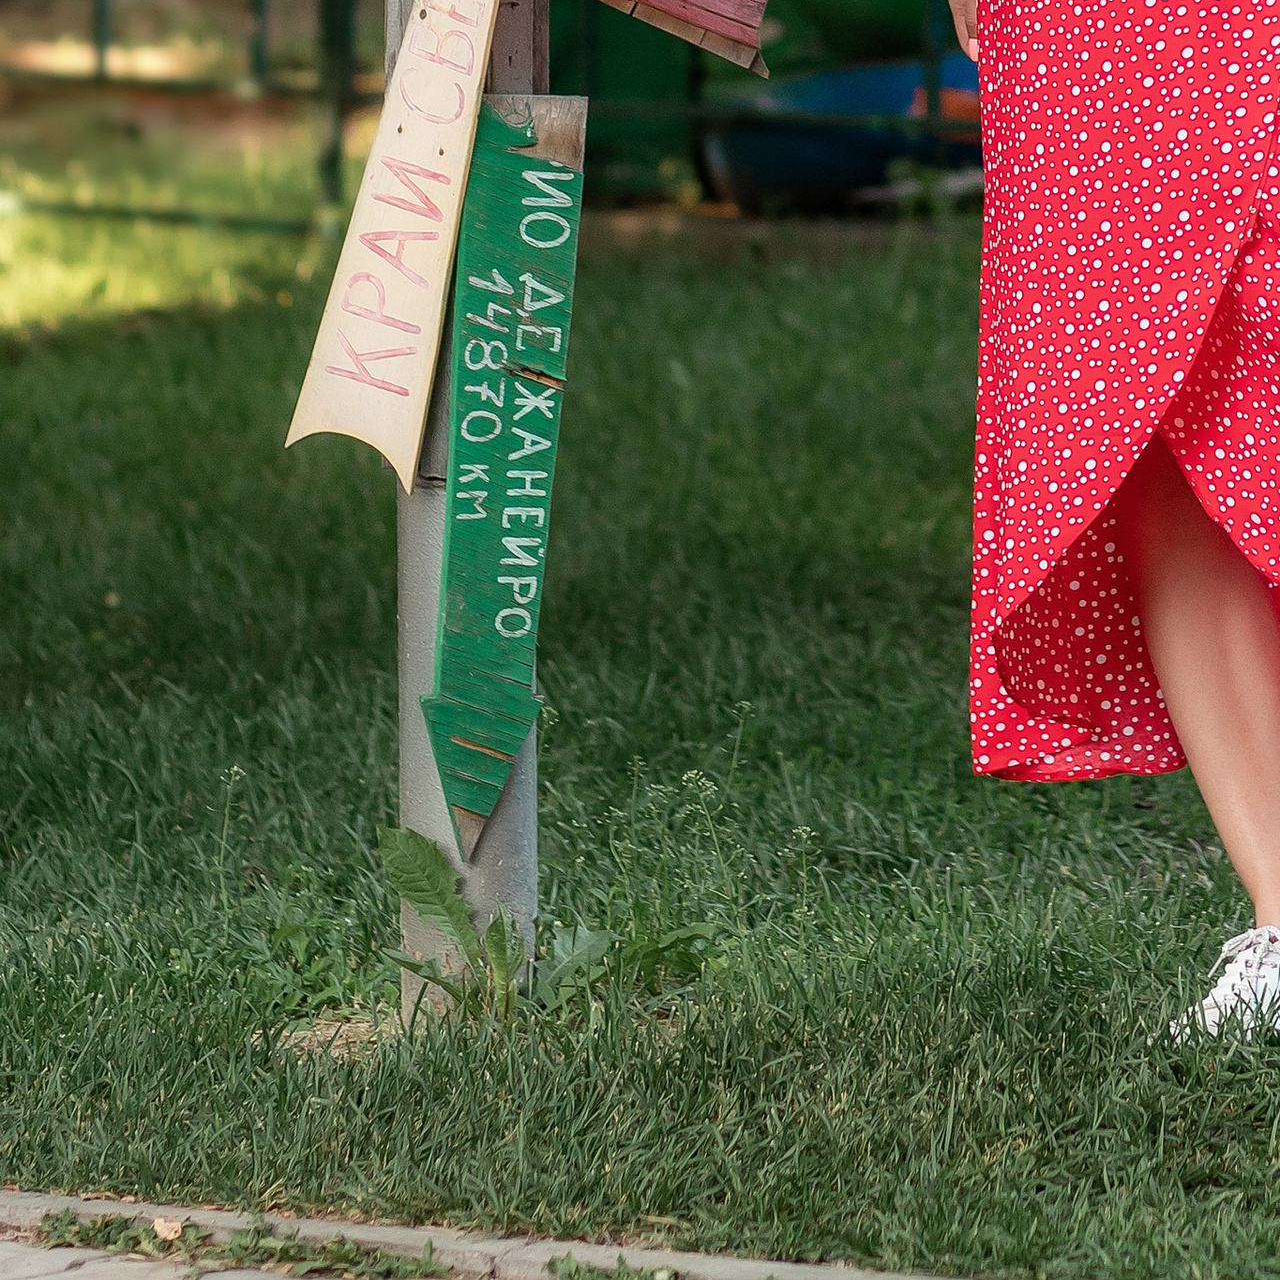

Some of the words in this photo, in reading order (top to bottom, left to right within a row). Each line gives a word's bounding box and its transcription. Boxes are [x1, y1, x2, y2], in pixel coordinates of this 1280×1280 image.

[325, 155, 452, 397] КРАЙ
[519, 161, 575, 249] ИО
[461, 268, 514, 442] 14870
[516, 272, 565, 352] ДЕ
[494, 381, 556, 638] ЖАНЕЙРО
